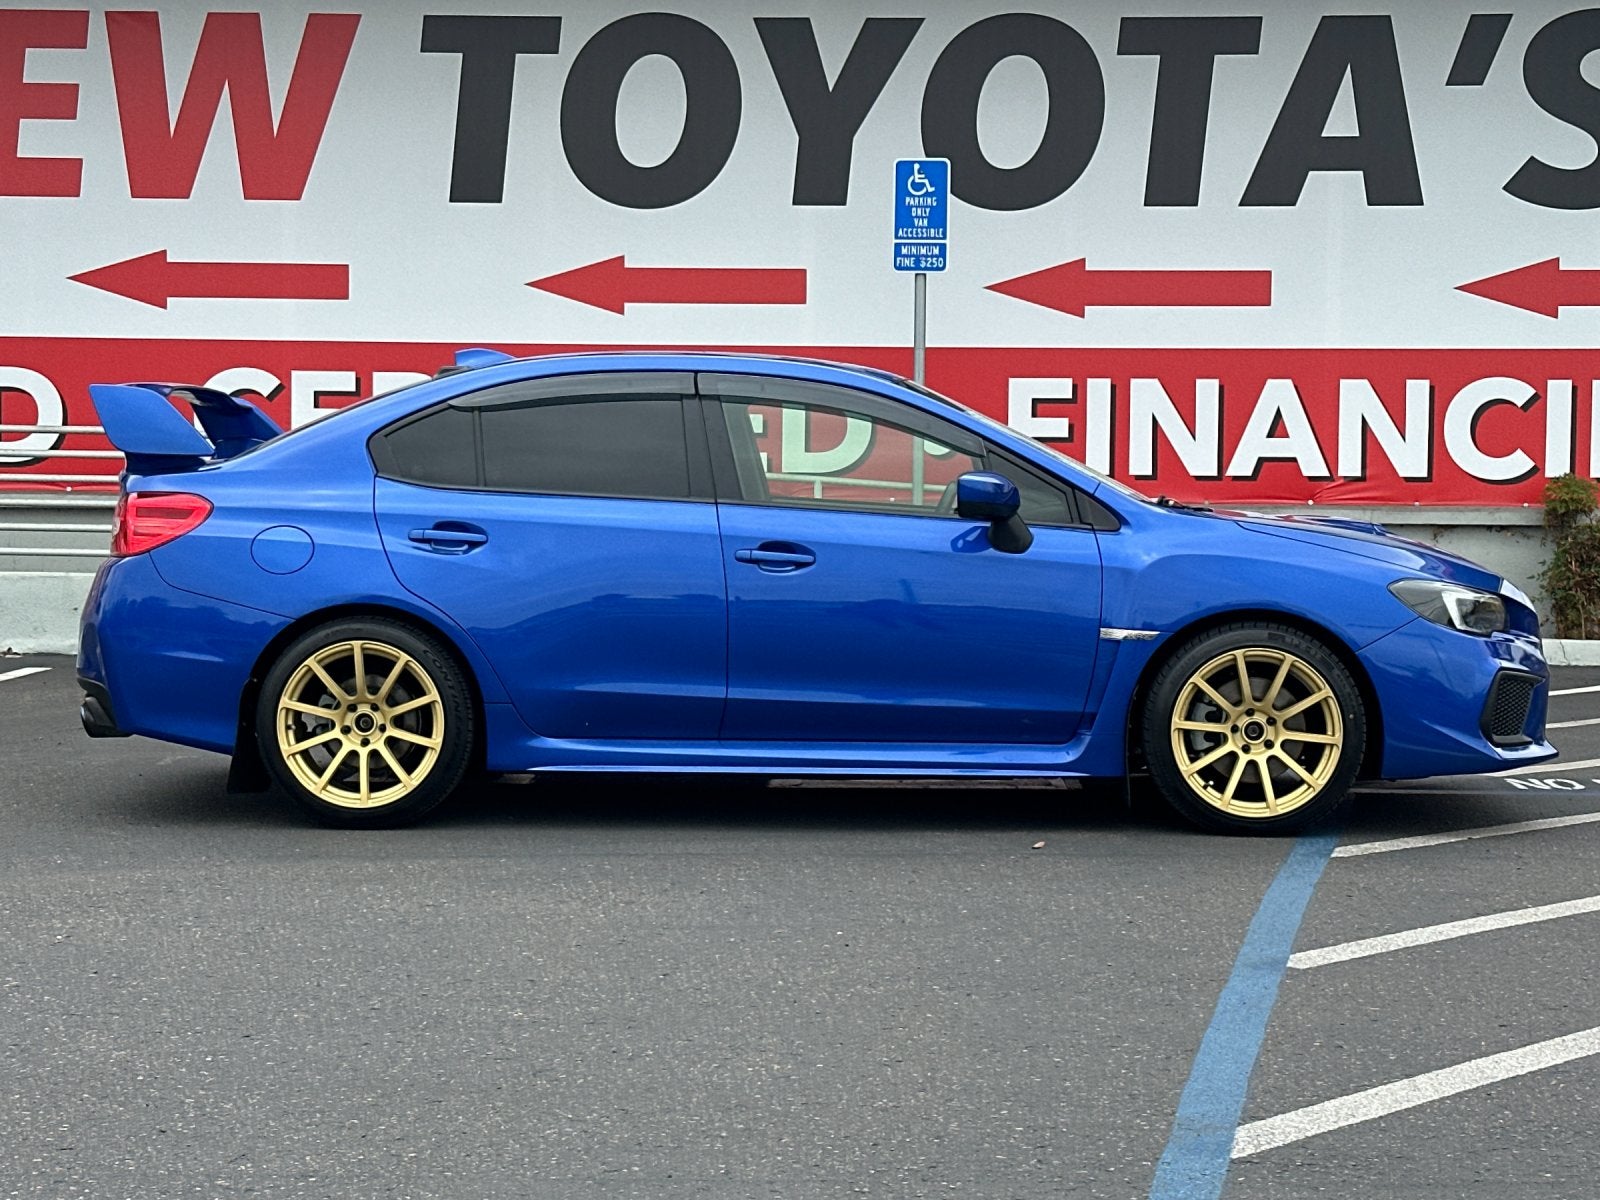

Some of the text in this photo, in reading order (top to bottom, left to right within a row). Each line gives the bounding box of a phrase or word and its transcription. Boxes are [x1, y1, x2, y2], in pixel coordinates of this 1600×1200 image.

[420, 8, 1600, 211] TOYOTA'S
[905, 196, 937, 207] PARKING
[911, 207, 931, 217] ONLY
[913, 218, 928, 227] VAN
[897, 228, 943, 238] ACCESSIBLE
[901, 245, 940, 256] MINIMUM
[896, 257, 944, 268] FINE $250
[1008, 376, 1600, 482] FINANCI
[1504, 778, 1586, 790] NO
